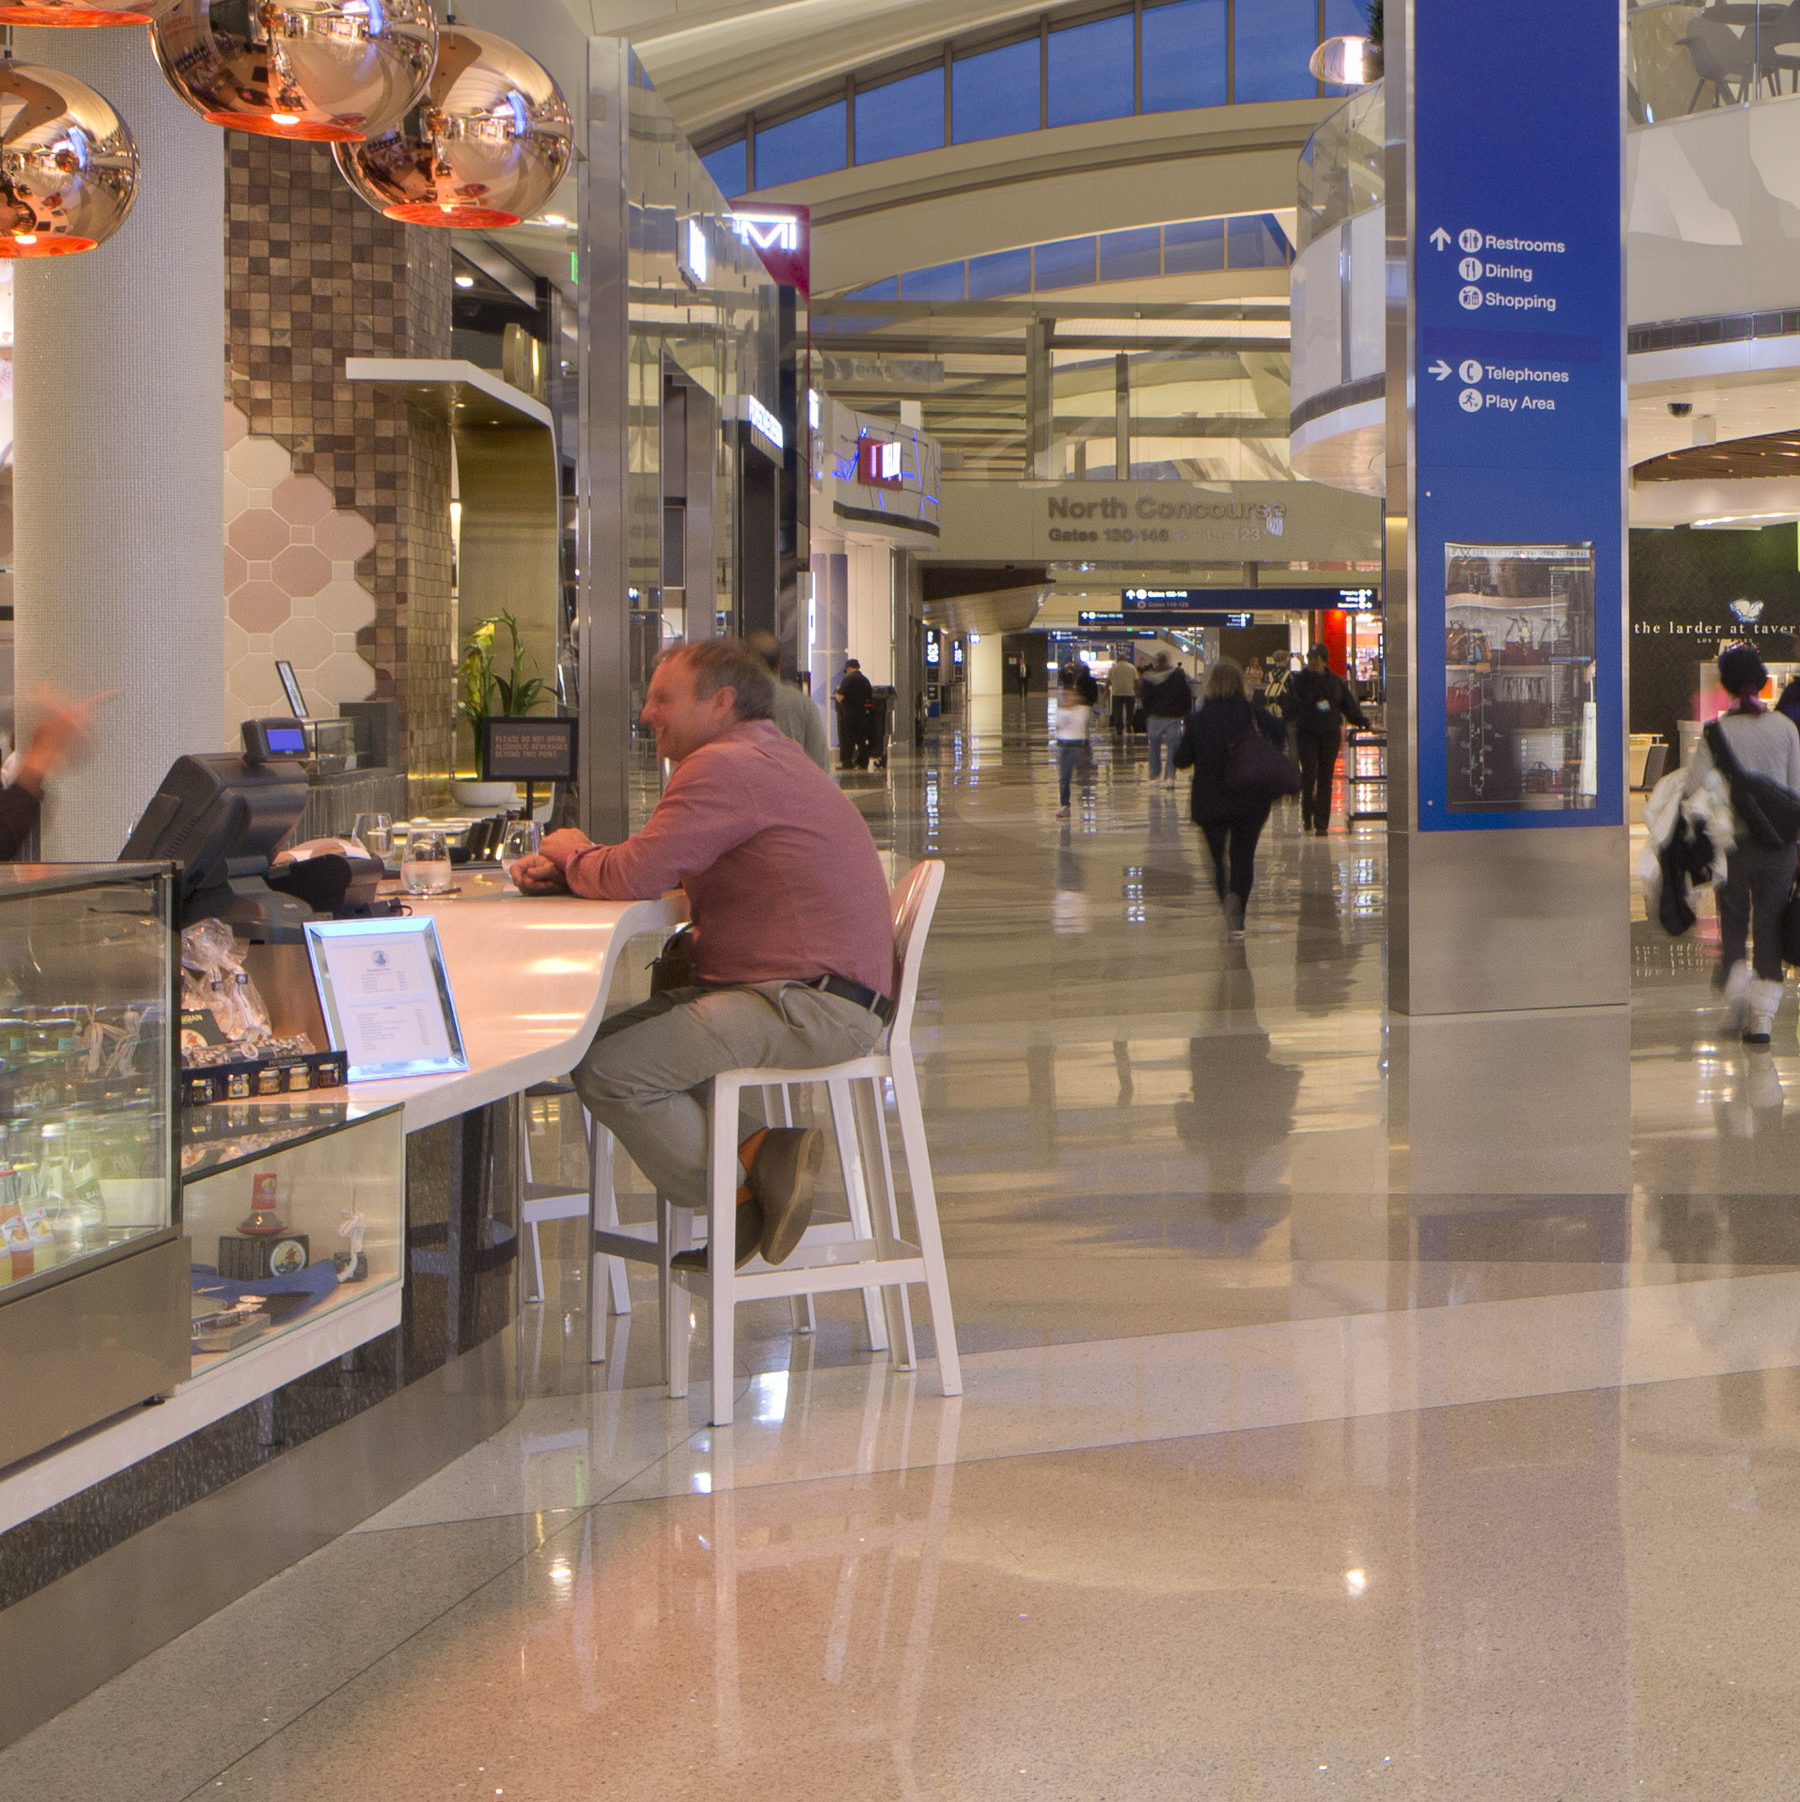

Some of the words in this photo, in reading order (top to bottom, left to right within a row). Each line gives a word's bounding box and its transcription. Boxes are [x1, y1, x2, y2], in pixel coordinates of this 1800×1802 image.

[1485, 235, 1566, 254] Restrooms
[1485, 264, 1533, 282] Dining
[1485, 292, 1556, 311] Shopping
[1485, 366, 1570, 384] Telephones
[1485, 394, 1517, 412] Play
[1521, 396, 1556, 411] Area
[1048, 497, 1128, 520] North
[1134, 497, 1288, 521] Concourse
[1048, 528, 1099, 543] Gates
[1103, 528, 1170, 543] 130-146
[1634, 621, 1662, 634] the
[1669, 621, 1722, 634] larder
[1730, 622, 1745, 634] at
